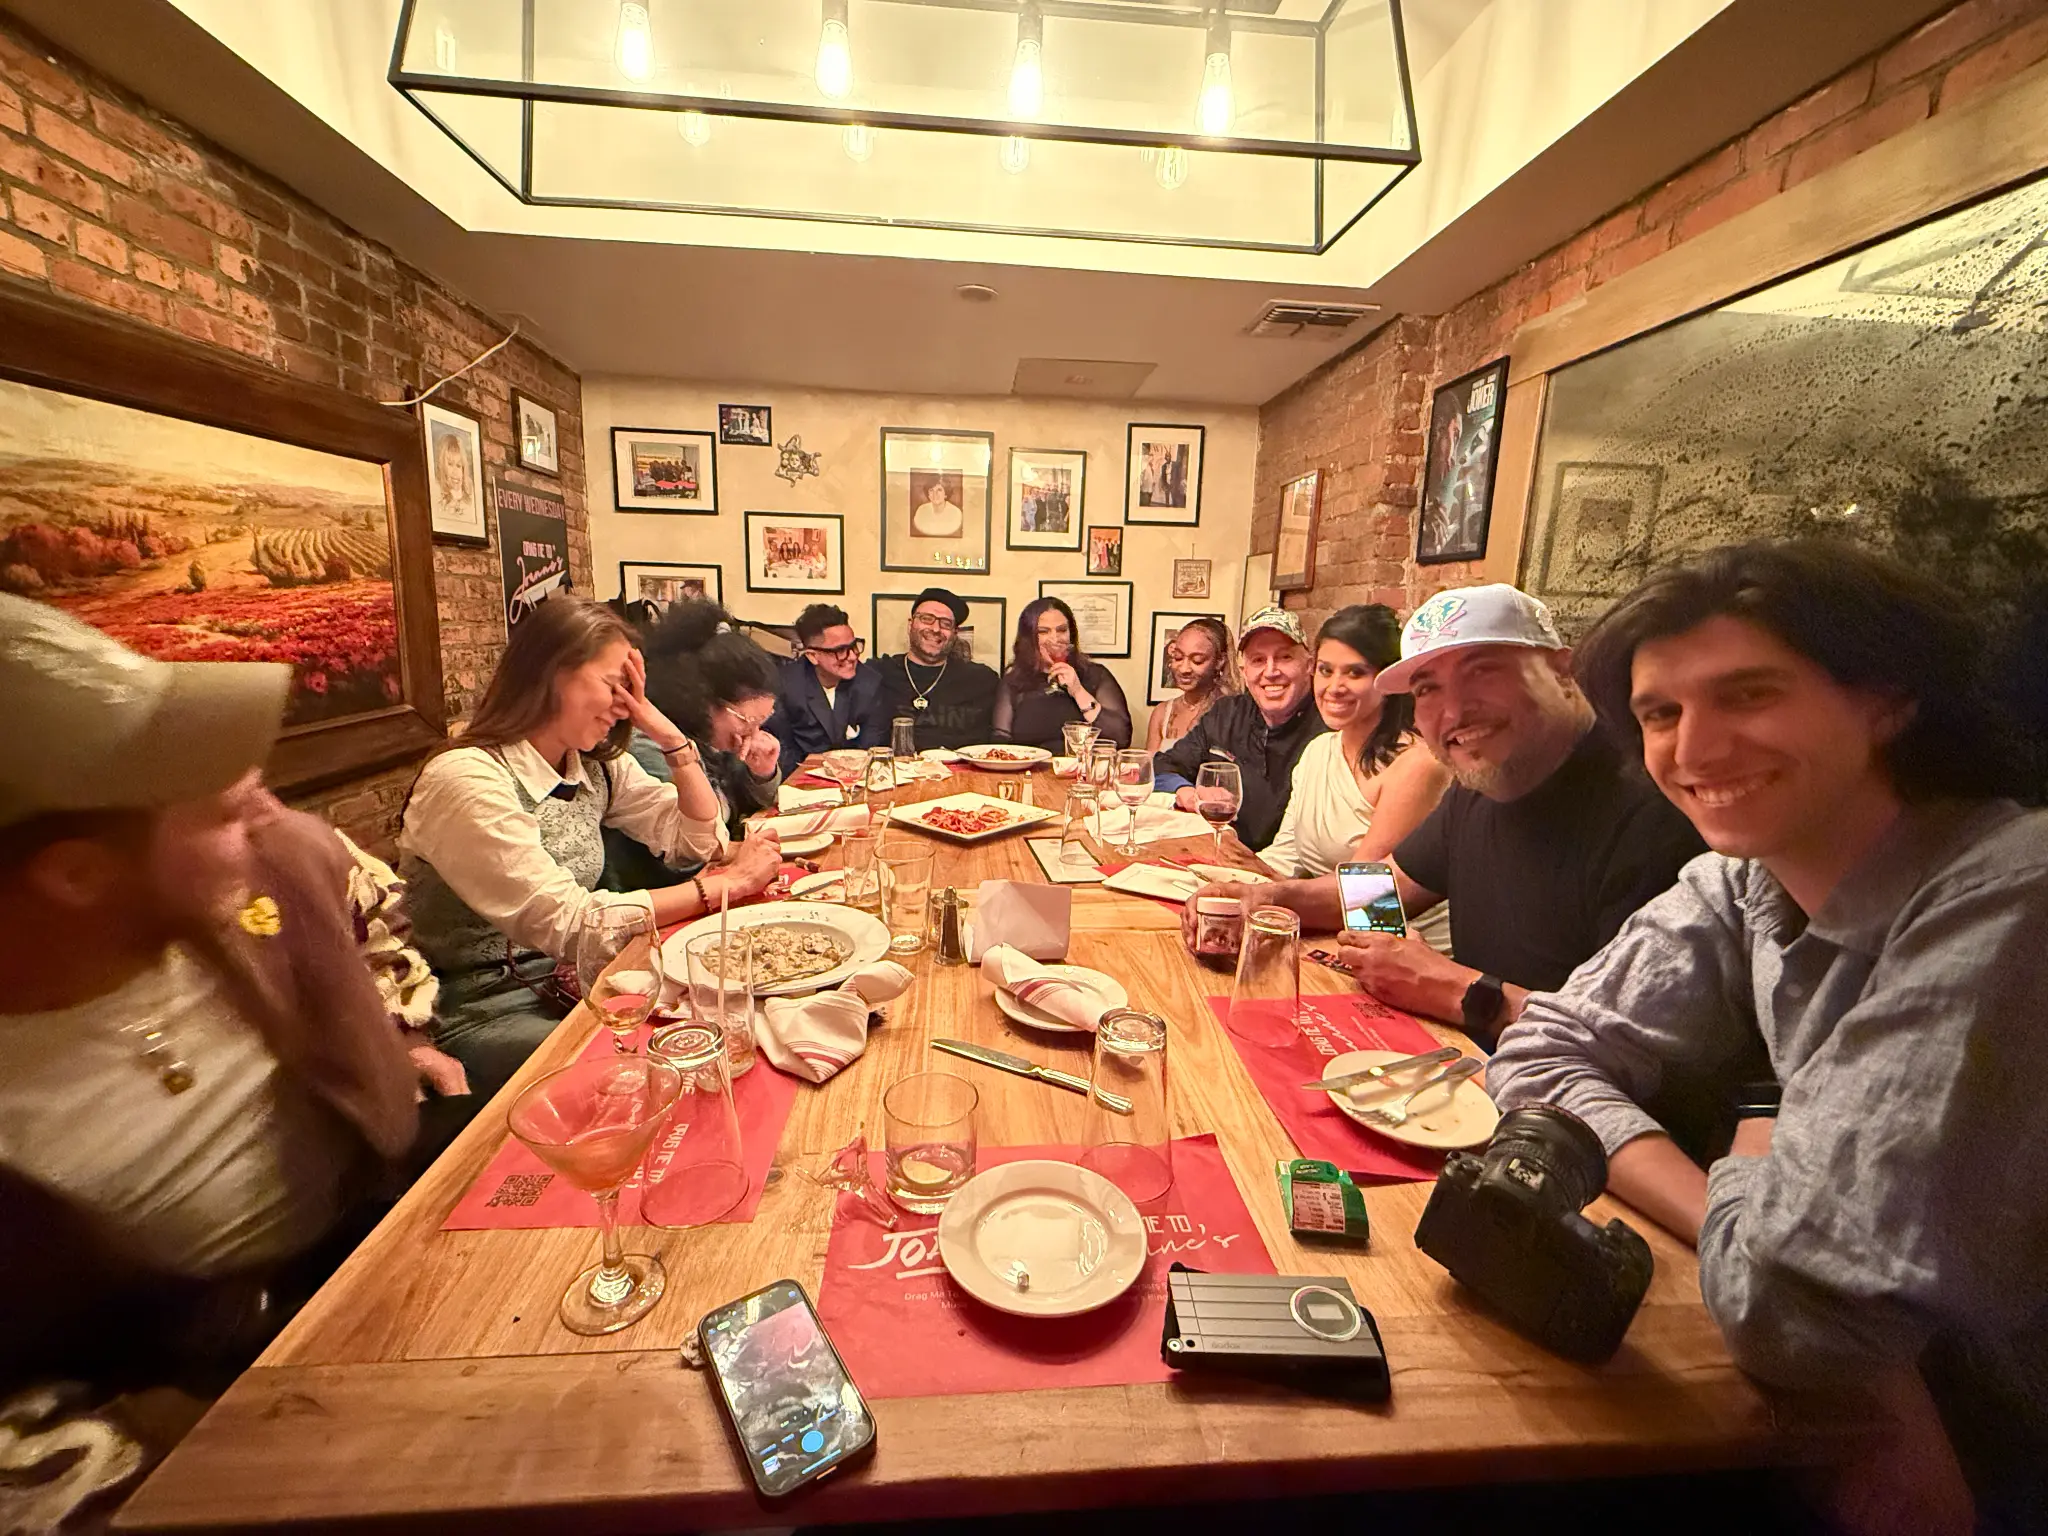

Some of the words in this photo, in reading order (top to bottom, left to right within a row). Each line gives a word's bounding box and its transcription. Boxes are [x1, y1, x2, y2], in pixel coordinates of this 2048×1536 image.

[1466, 382, 1495, 414] JOKER
[497, 488, 523, 512] EVERY
[523, 494, 565, 520] WEDNESDAY
[1164, 1214, 1193, 1233] TO
[903, 1292, 929, 1302] Drag
